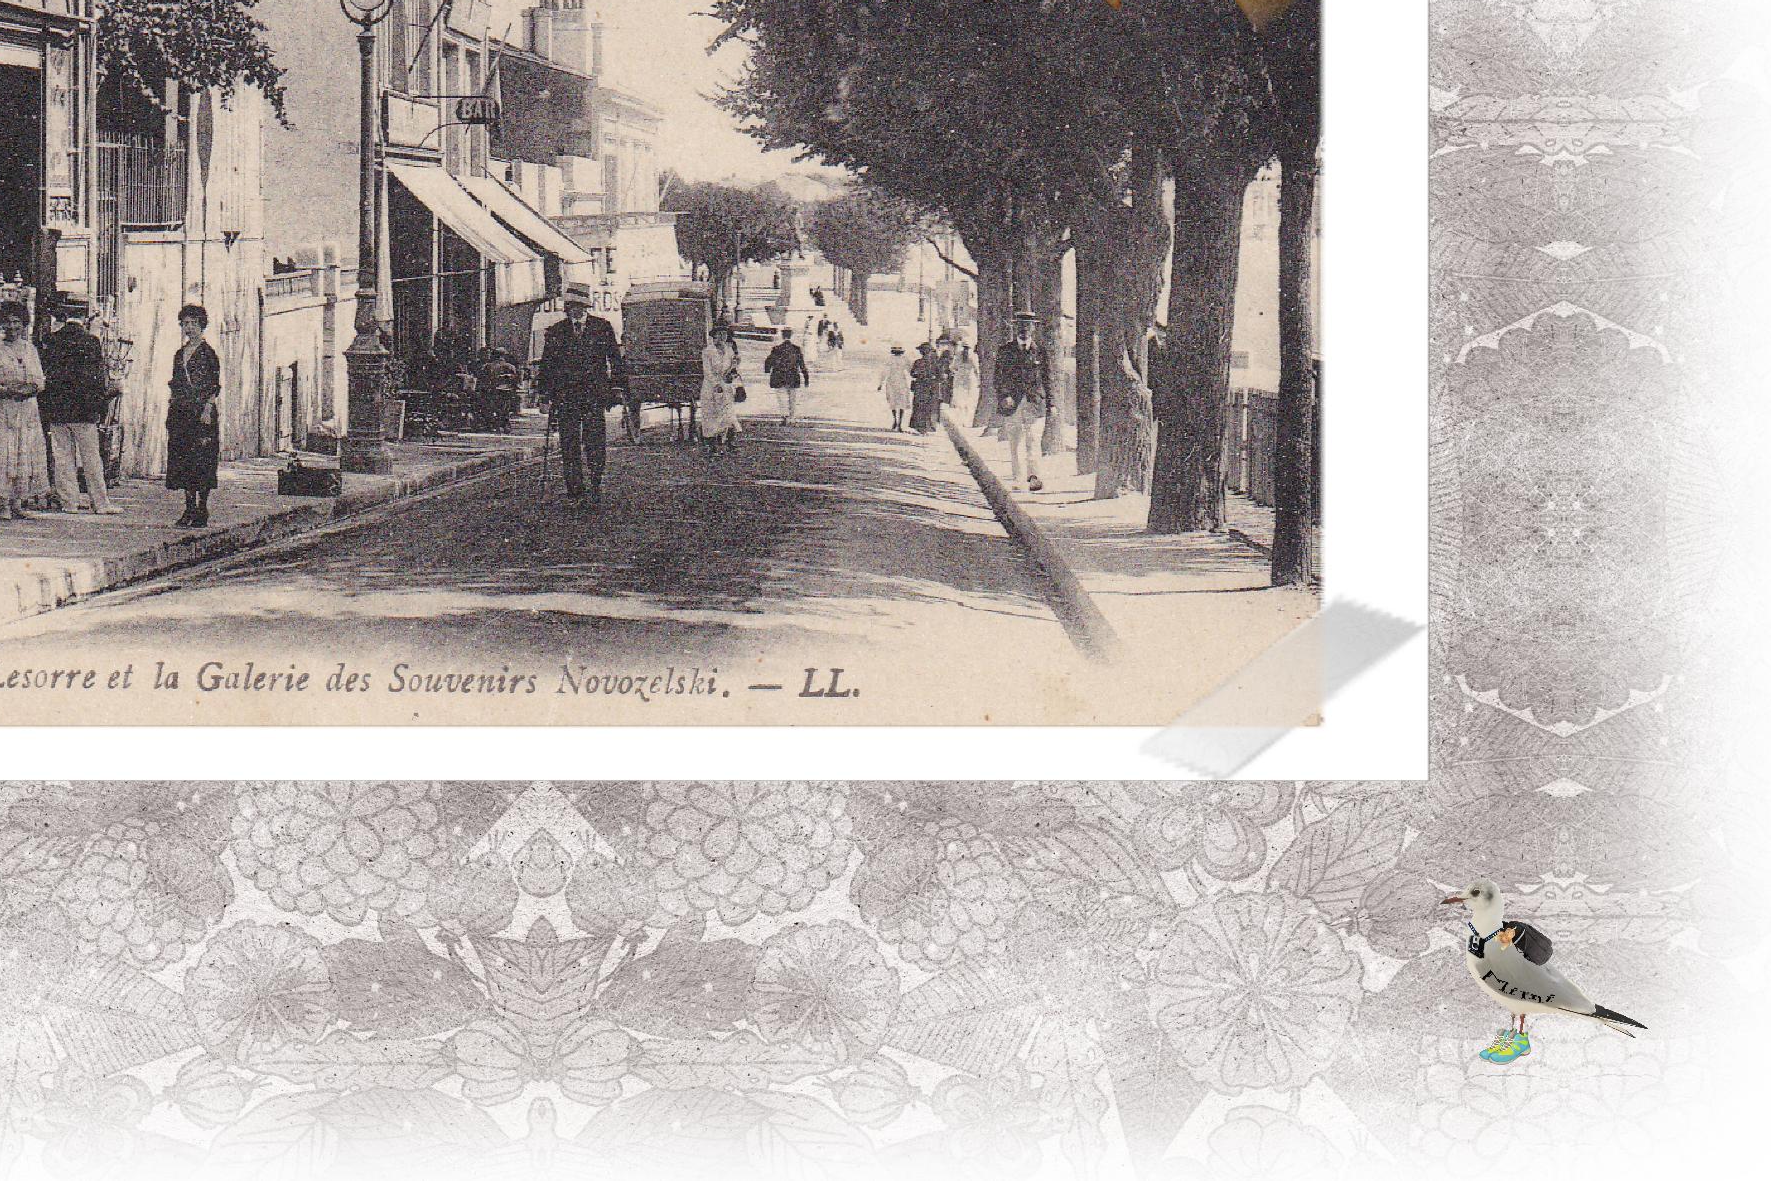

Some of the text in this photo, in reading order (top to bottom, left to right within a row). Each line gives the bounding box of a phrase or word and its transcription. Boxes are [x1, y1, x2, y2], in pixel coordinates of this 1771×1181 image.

[460, 99, 496, 119] BAR
[107, 662, 134, 690] et
[154, 661, 179, 690] la
[197, 661, 310, 692] Galerie
[326, 662, 372, 693] des
[388, 663, 537, 695] Souvenirs
[555, 664, 731, 703] Novozelski.
[798, 667, 861, 698] LL.
